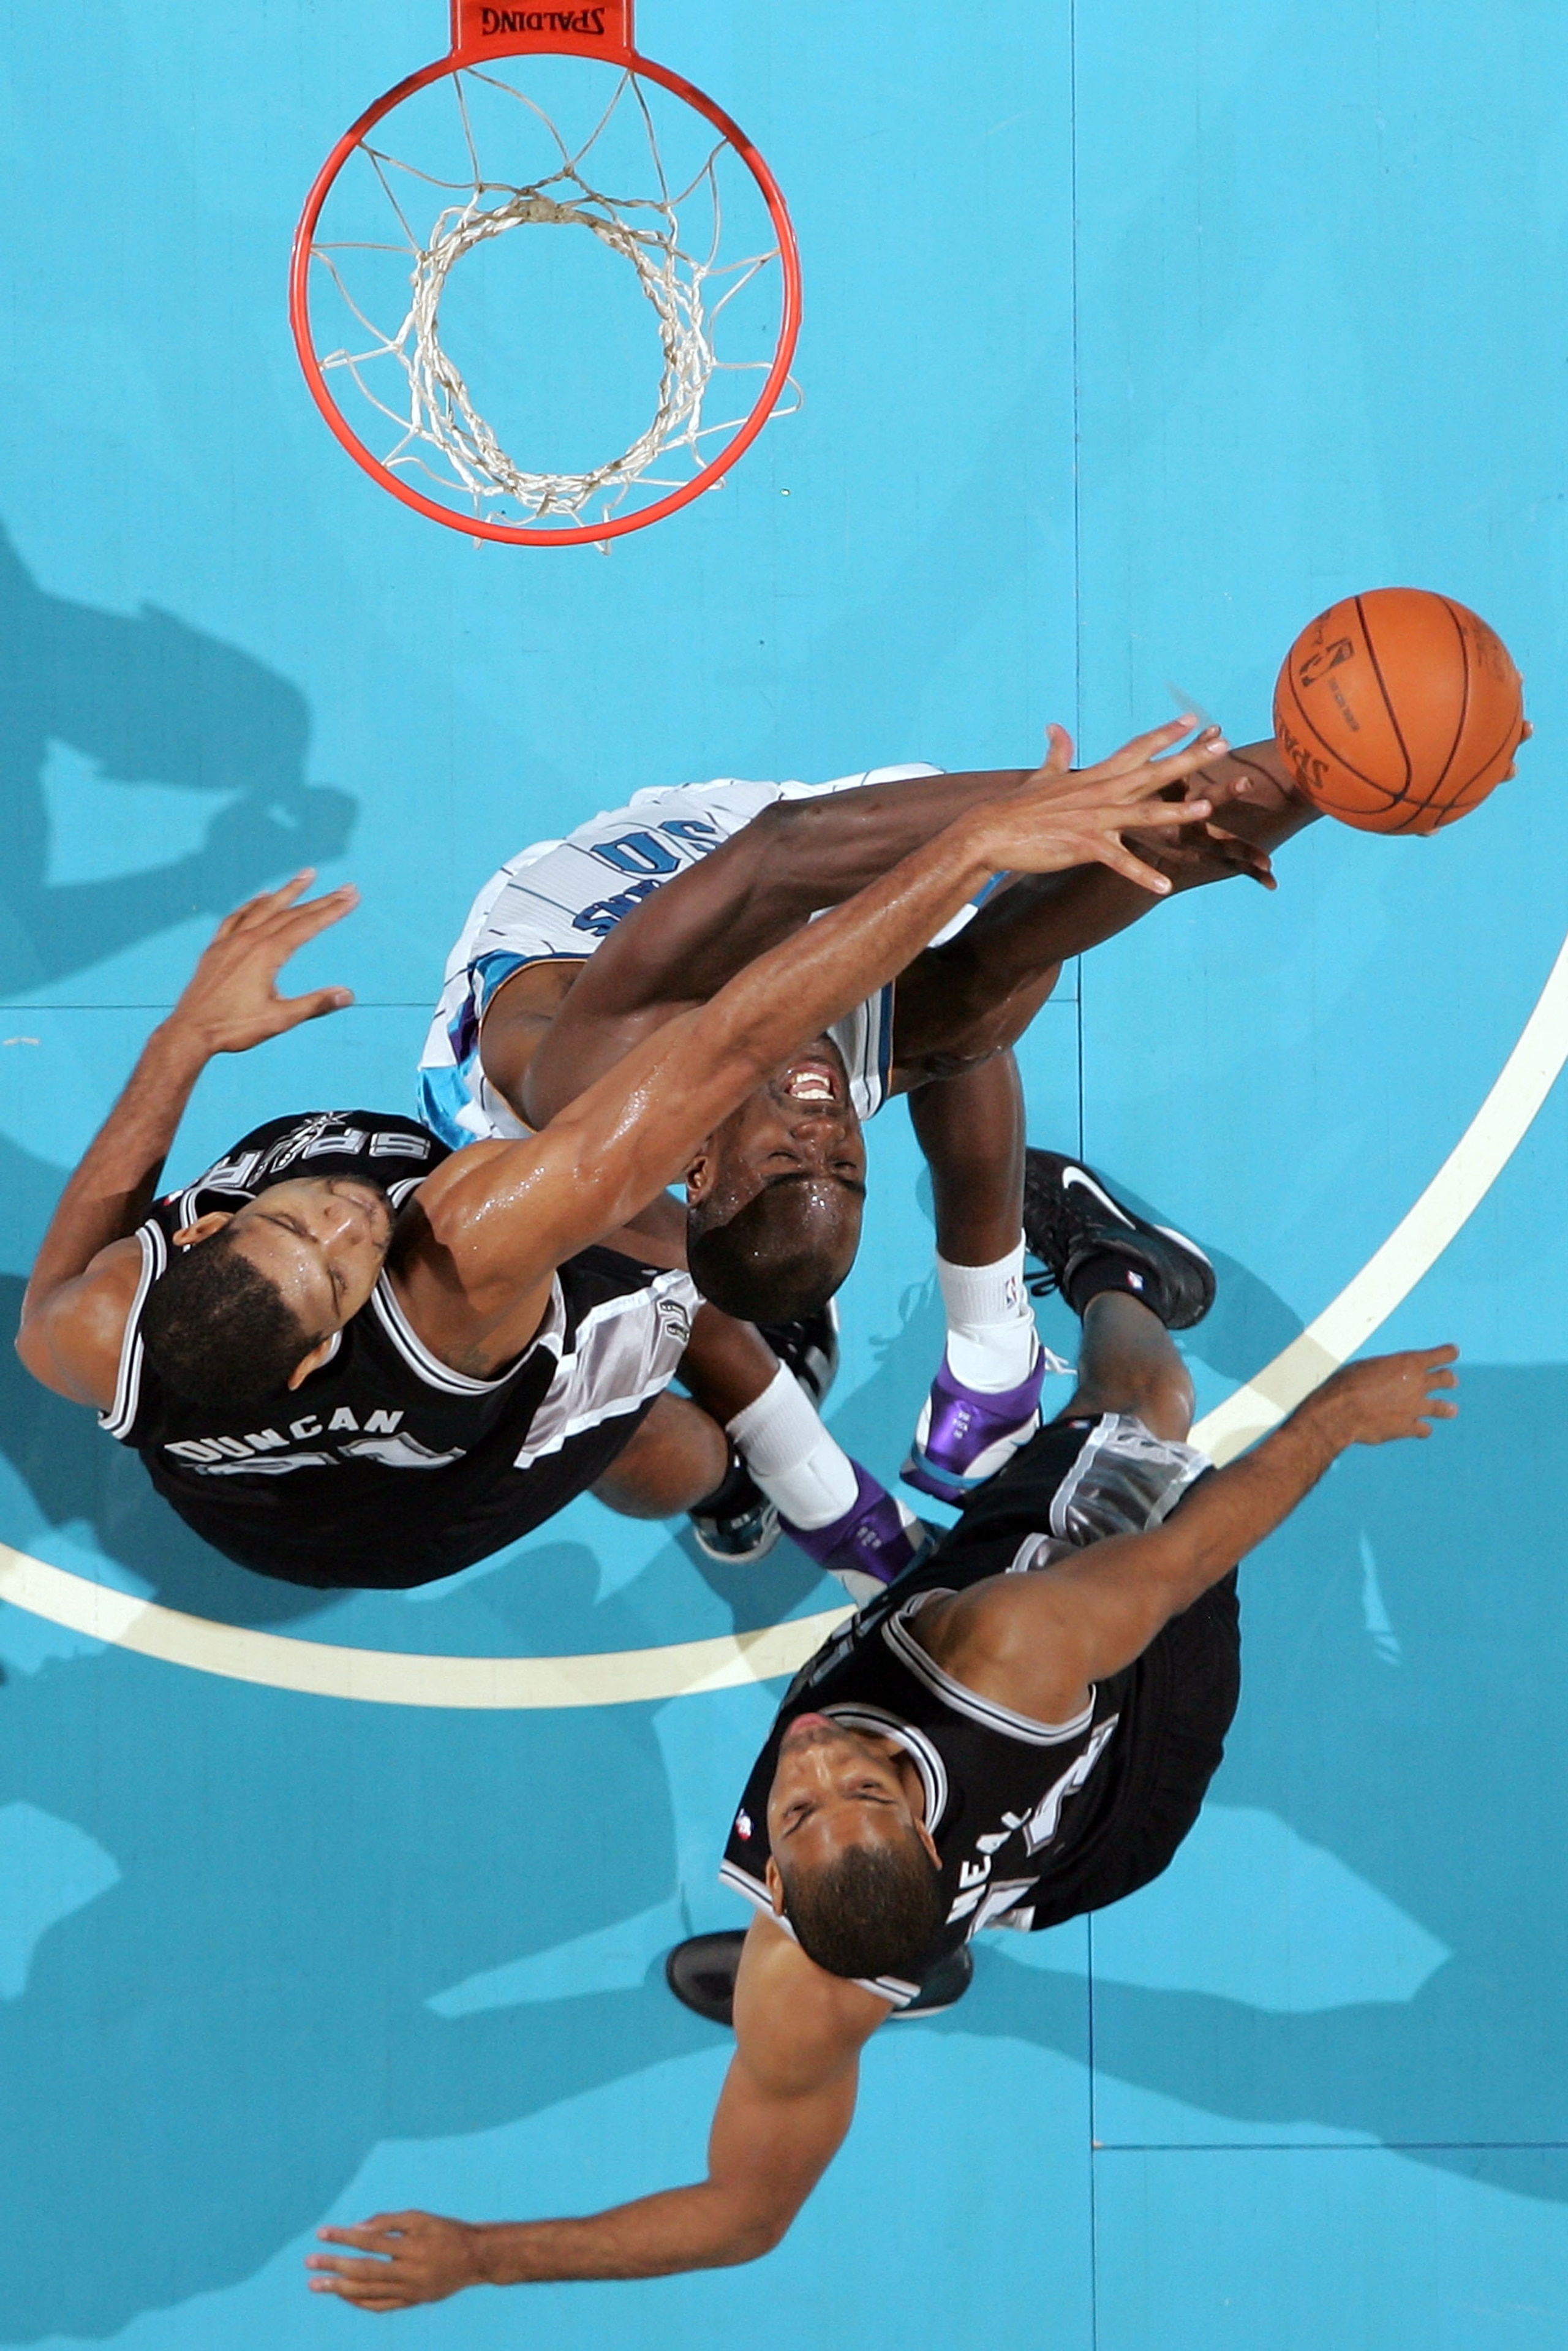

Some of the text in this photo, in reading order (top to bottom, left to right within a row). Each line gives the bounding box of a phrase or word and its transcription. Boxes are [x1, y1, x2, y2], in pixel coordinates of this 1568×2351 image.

[481, 7, 605, 36] SPALDING
[165, 1407, 404, 1463] DUNCAN
[944, 1807, 1033, 1925] NEAL
